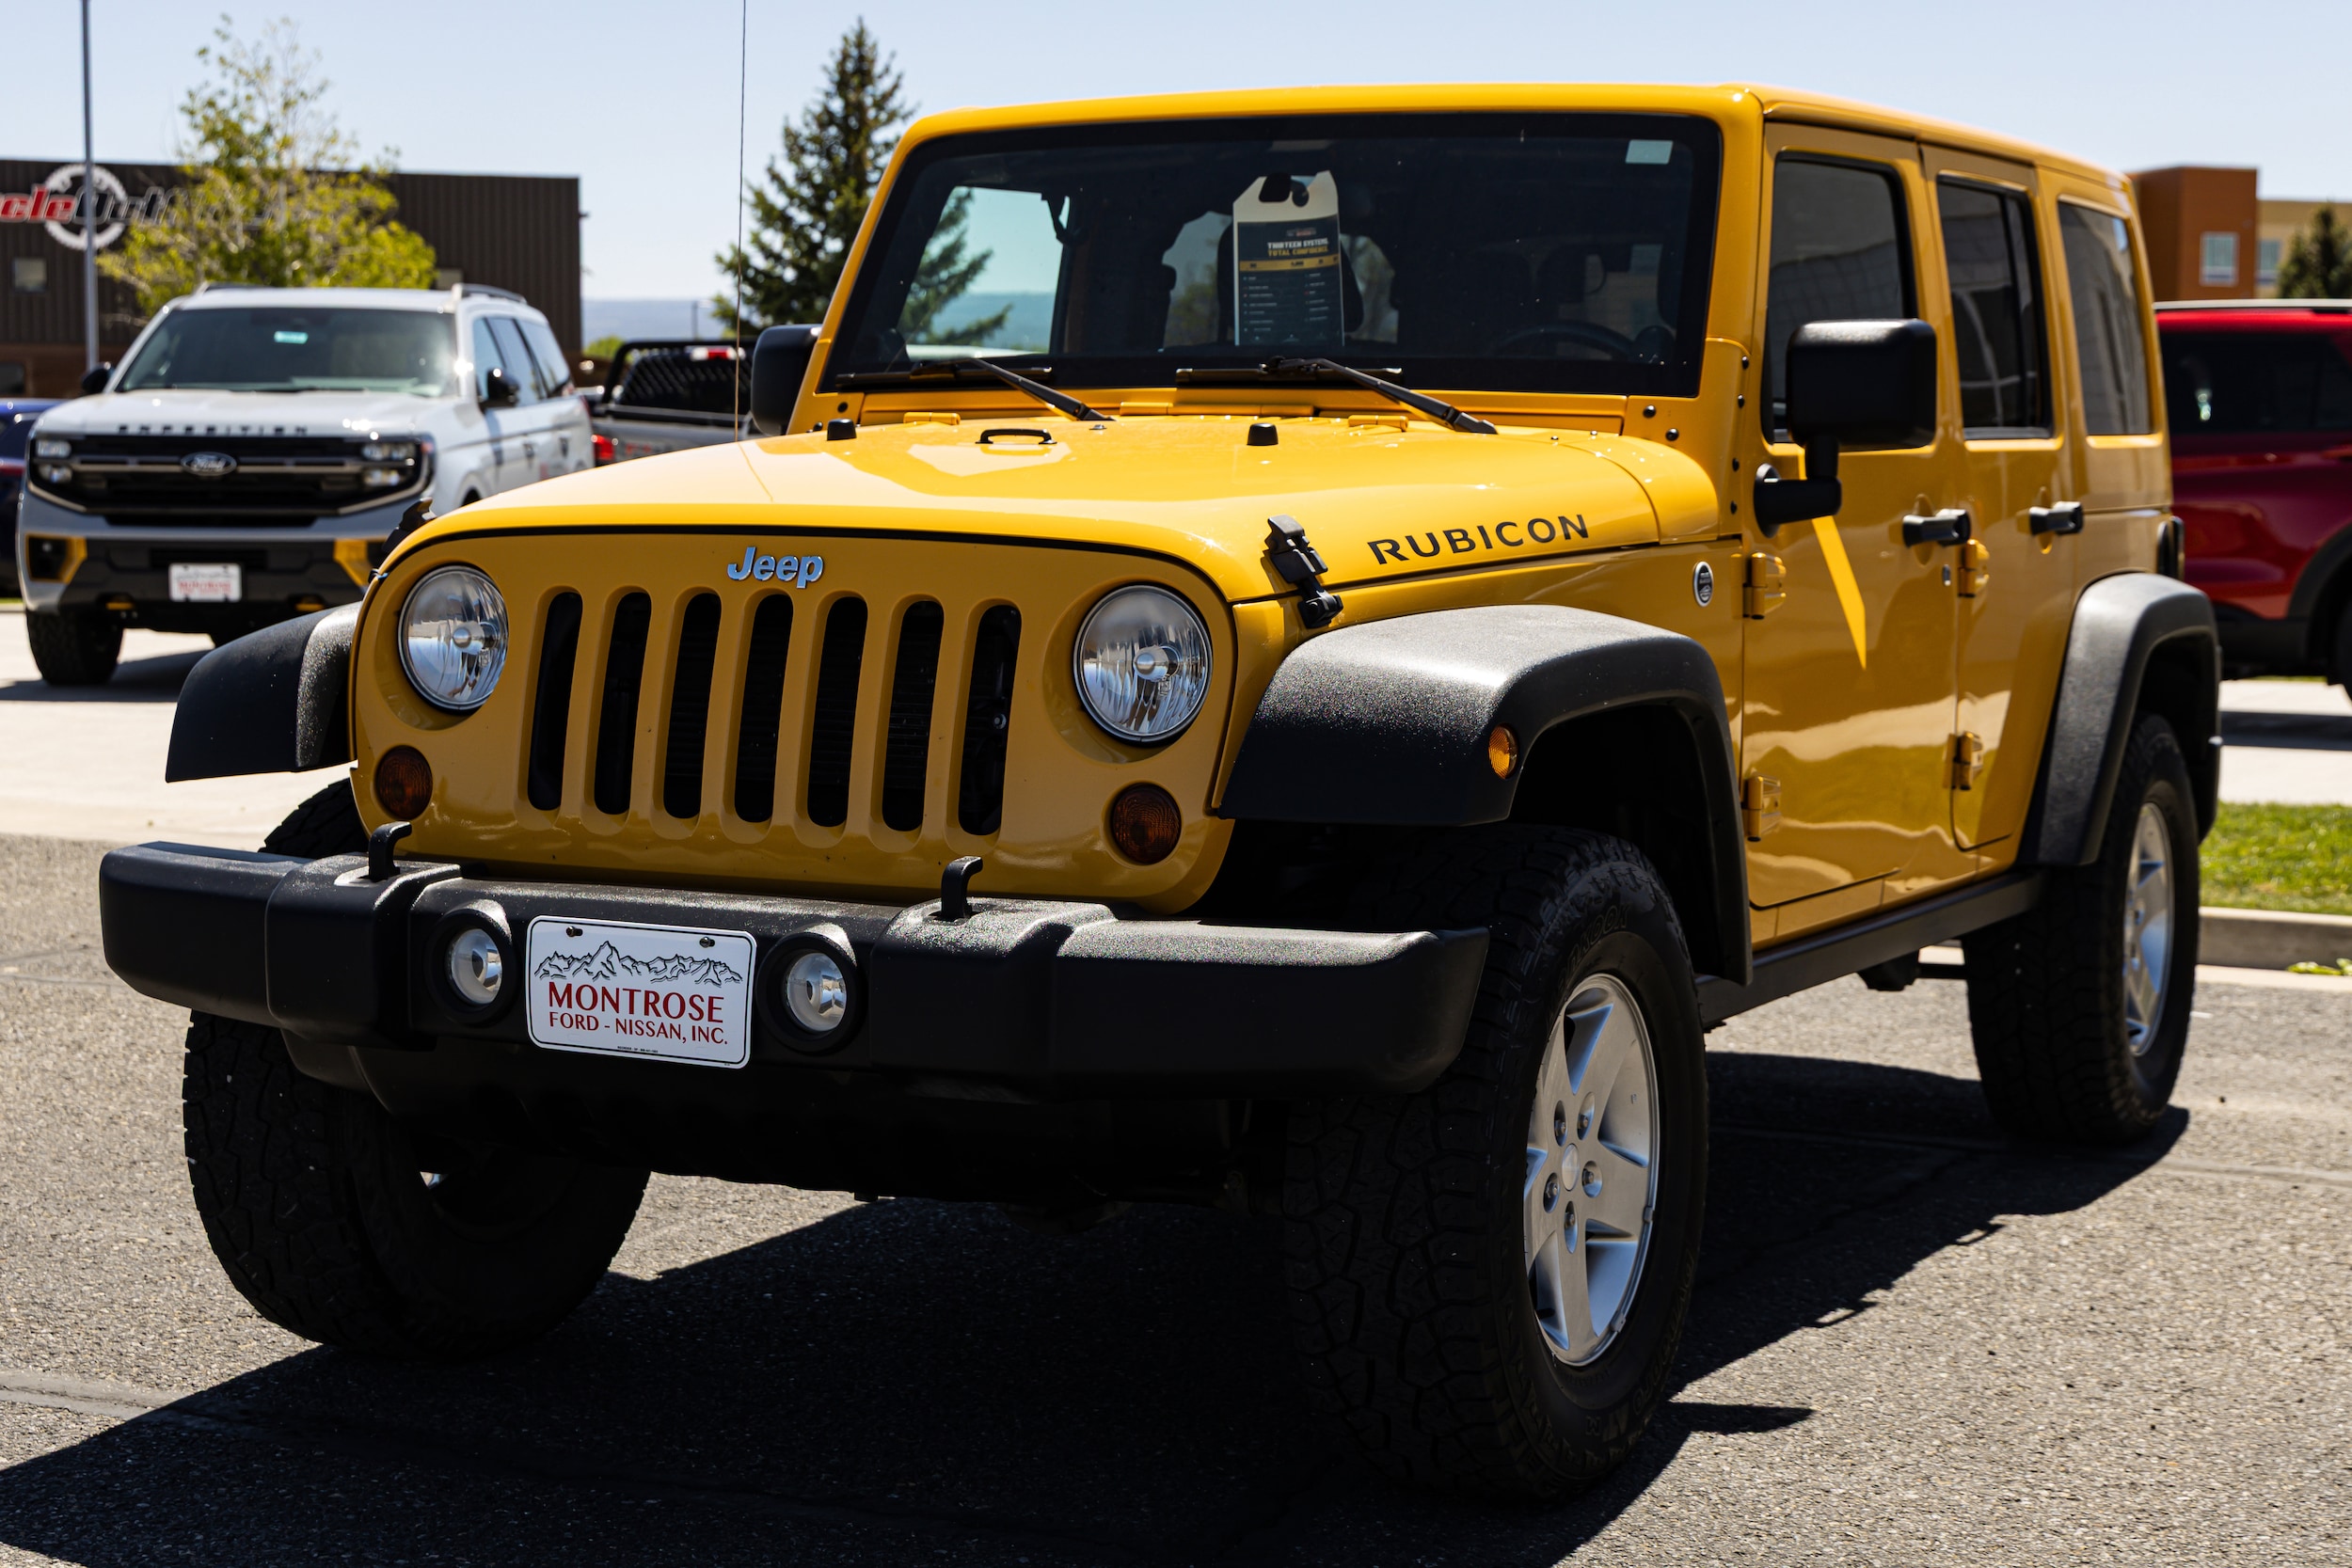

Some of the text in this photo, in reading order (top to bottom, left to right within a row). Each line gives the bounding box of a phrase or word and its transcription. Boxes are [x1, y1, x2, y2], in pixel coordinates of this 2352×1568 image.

[193, 453, 227, 472] Ford
[1368, 514, 1589, 565] RUBICON
[727, 546, 824, 589] Jeep
[548, 981, 724, 1023] MONTROSE
[549, 1012, 599, 1031] FORD
[615, 1018, 688, 1045] NISSAN,
[691, 1025, 728, 1045] INC.
